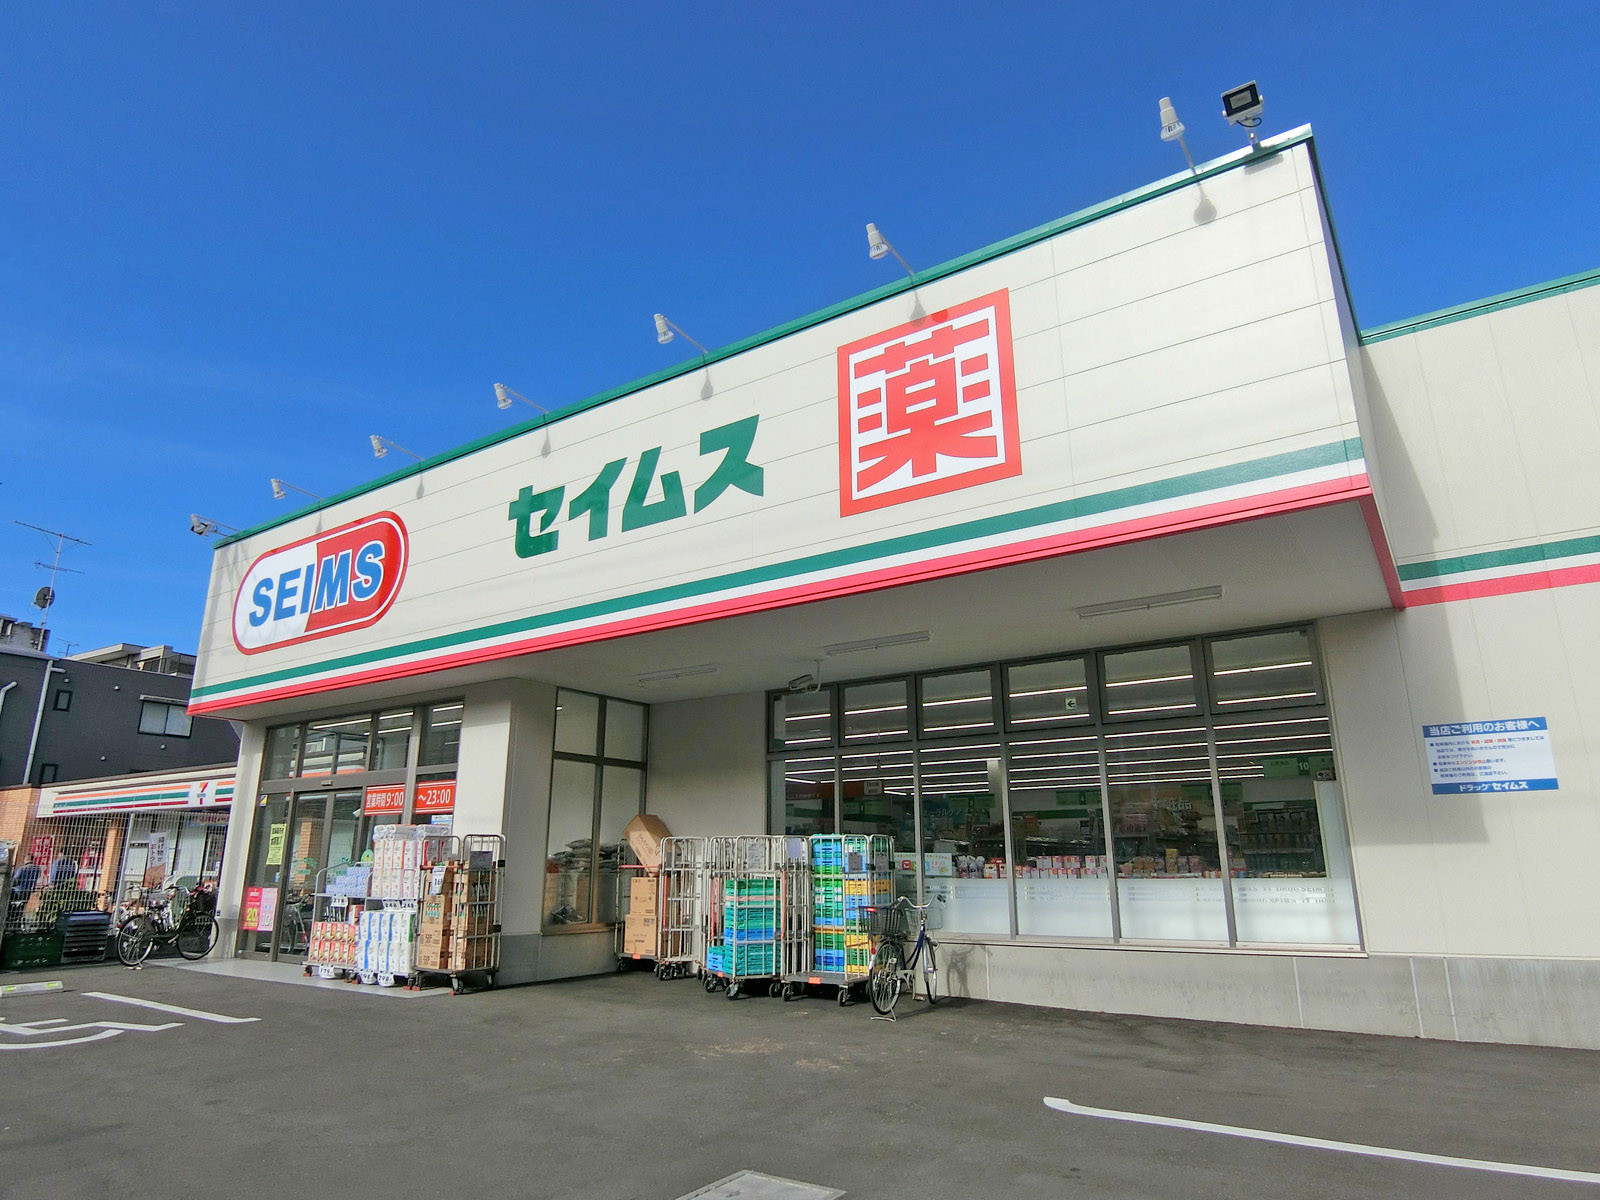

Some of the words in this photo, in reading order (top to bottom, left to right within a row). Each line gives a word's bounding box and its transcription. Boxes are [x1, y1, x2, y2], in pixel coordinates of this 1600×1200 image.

[855, 318, 998, 493] 薬
[508, 414, 764, 559] セイムス
[248, 540, 385, 628] SEIMS
[1429, 719, 1540, 736] 当店ご利用のお客様へ
[1459, 782, 1491, 792] ドラッグ
[1491, 781, 1529, 791] セイムス
